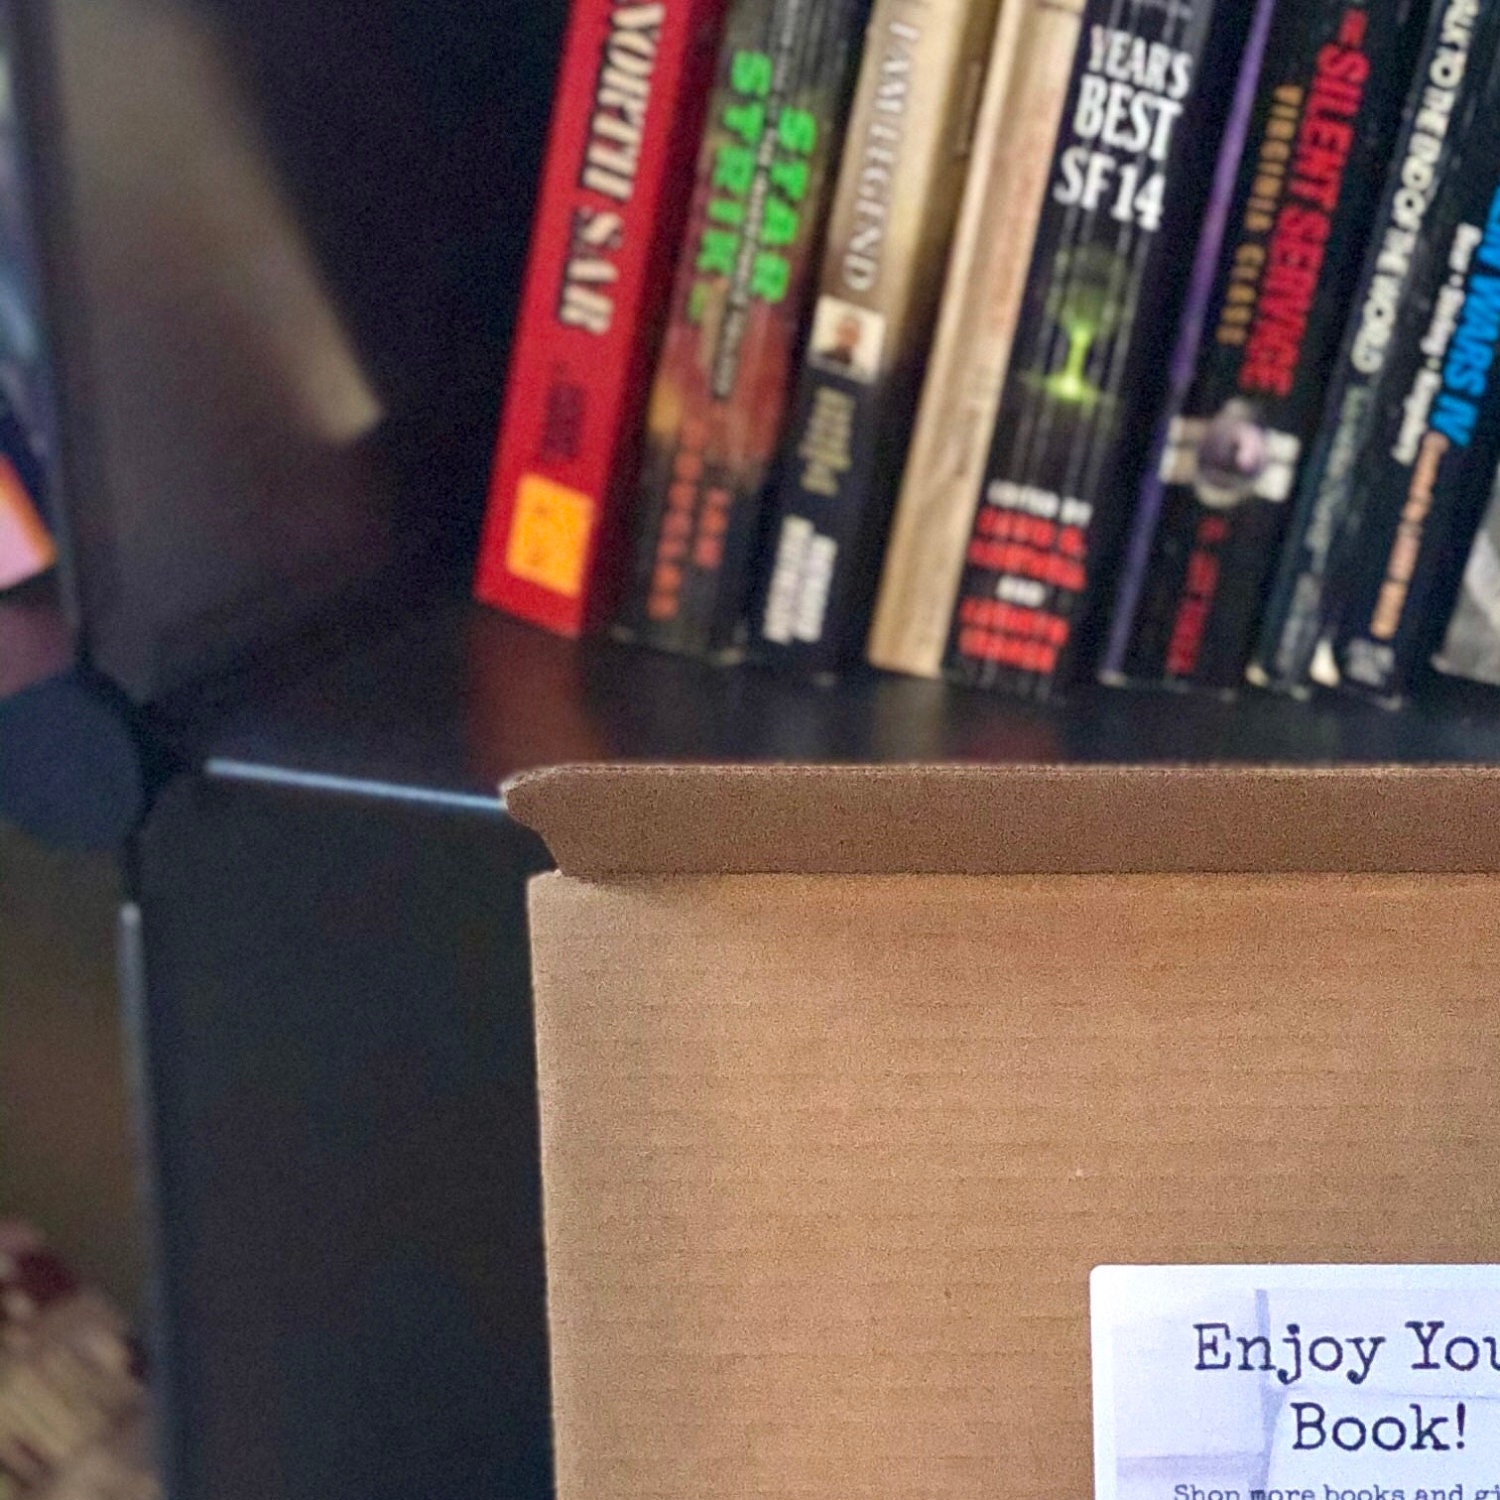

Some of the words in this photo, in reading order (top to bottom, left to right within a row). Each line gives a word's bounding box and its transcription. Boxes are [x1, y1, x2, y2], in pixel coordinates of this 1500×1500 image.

[1074, 76, 1182, 160] BEST
[1292, 45, 1369, 211] SILENT
[750, 107, 816, 302] STAR
[1053, 147, 1117, 209] SF
[1111, 166, 1166, 232] 14
[1240, 208, 1330, 395] SERVICE
[1192, 1322, 1386, 1385] Enjoy
[1290, 1401, 1468, 1451] Book!
